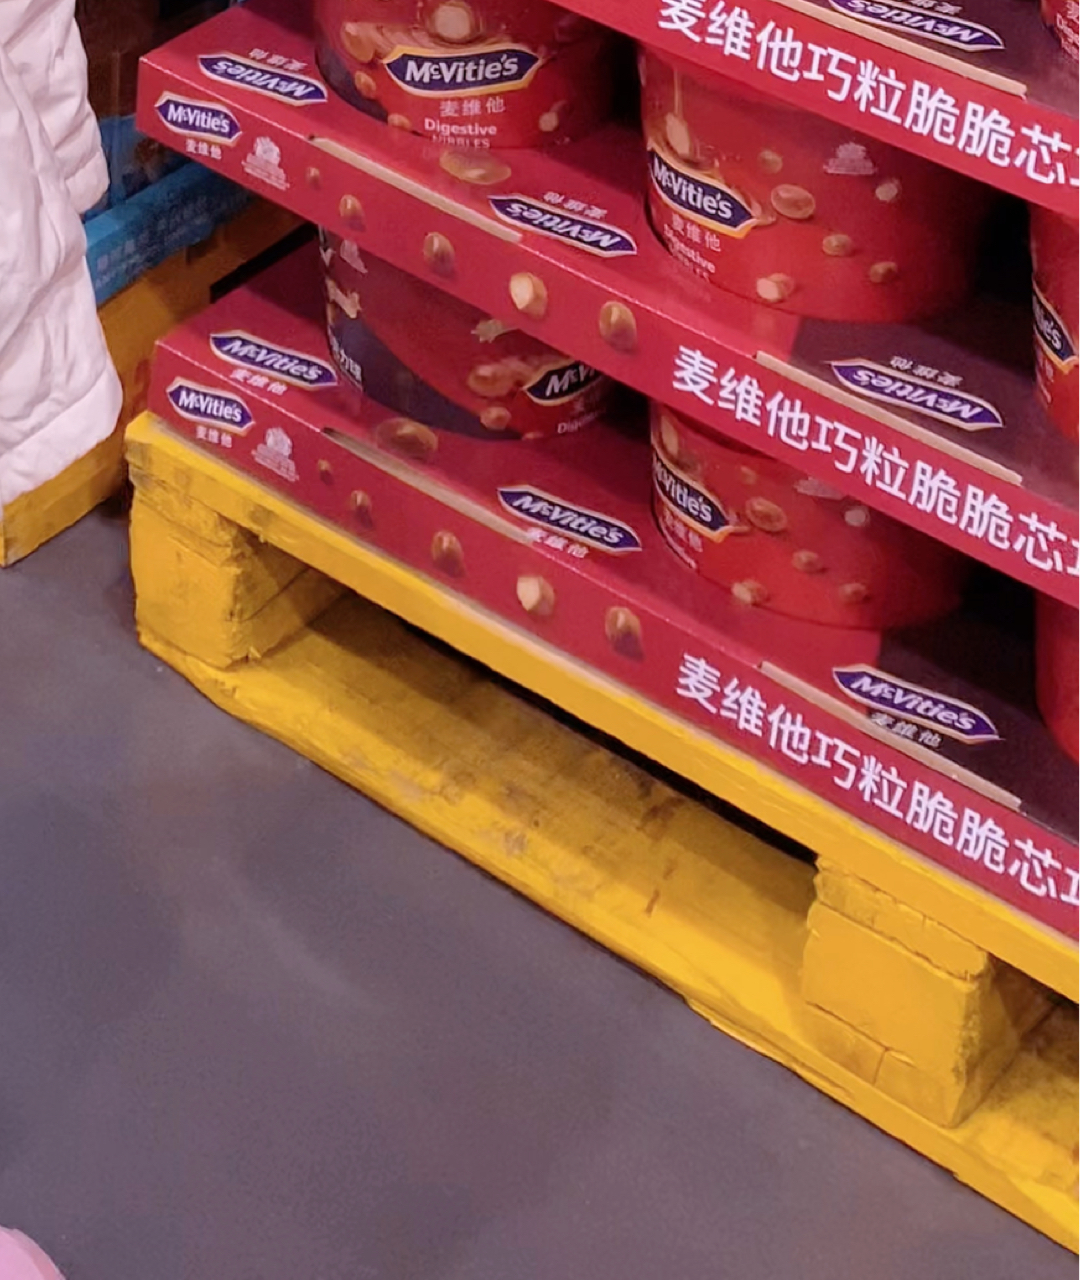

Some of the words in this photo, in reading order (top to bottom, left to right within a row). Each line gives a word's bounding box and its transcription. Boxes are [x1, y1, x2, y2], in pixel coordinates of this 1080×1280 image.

[848, 0, 983, 42] McVitie's
[214, 60, 314, 97] McVitie's
[406, 54, 519, 84] McVitie's
[167, 104, 230, 133] McVitie's
[424, 117, 497, 138] Digestive
[439, 96, 506, 118] 麦维他
[654, 155, 732, 219] McVitie's
[507, 202, 622, 248] McVitie's
[222, 340, 322, 381] McVitie's
[178, 389, 242, 422] McVitie's
[853, 369, 984, 419] McVitie's
[513, 495, 623, 543] McVitie's
[850, 676, 976, 730] McVitie's
